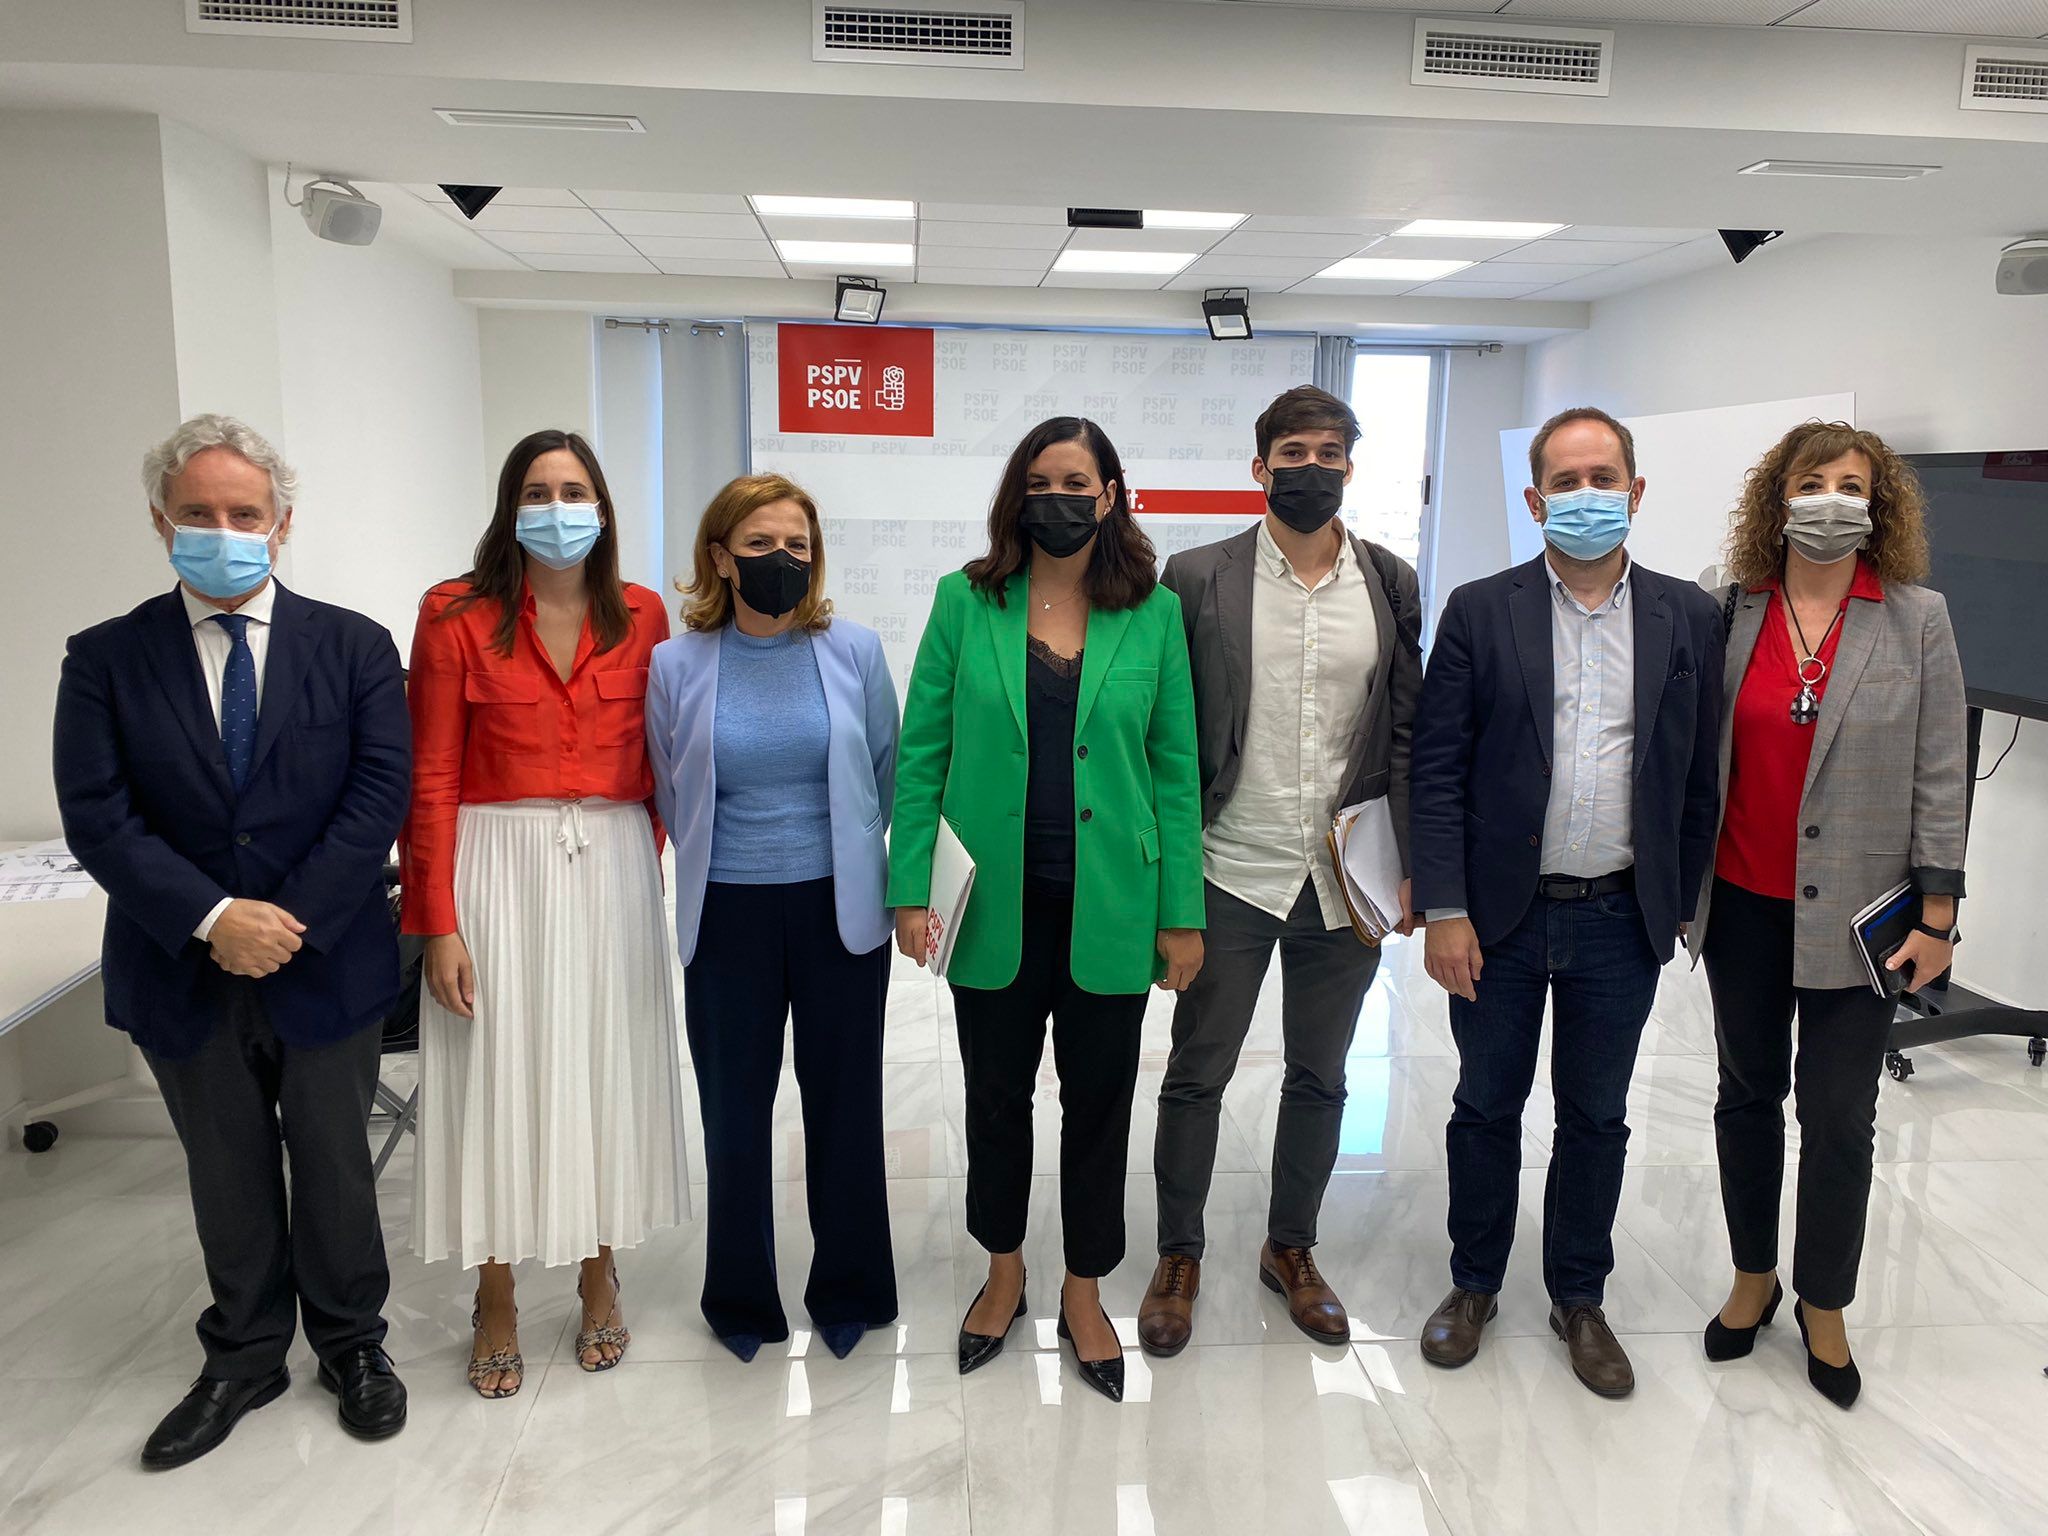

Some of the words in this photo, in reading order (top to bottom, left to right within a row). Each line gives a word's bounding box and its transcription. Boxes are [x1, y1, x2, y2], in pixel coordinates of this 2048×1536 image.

[992, 343, 1028, 356] PSPV
[1053, 344, 1088, 358] PSPV
[1112, 345, 1148, 359] PSPV
[1172, 347, 1207, 361] PSPV
[1231, 347, 1266, 361] PSPV
[992, 359, 1027, 372] PSOE
[1053, 360, 1087, 373] PSOE
[1112, 361, 1147, 375] PSOE
[1171, 363, 1205, 376] PSOE
[1230, 363, 1264, 377] PSOE
[807, 365, 862, 386] PSPV
[808, 389, 861, 410] PSOE
[964, 392, 999, 406] PSPV
[1024, 394, 1059, 408] PSPV
[1083, 396, 1117, 409] PSPV
[1142, 398, 1177, 411] PSPV
[1202, 398, 1236, 411] PSPV
[963, 408, 998, 421] PSOE
[1142, 412, 1176, 425] PSOE
[1201, 413, 1235, 426] PSOE
[810, 440, 846, 453] PSPV
[872, 441, 907, 454] PSPV
[932, 443, 967, 456] PSPV
[1169, 448, 1204, 460] PSPV
[872, 520, 907, 532] PSPV
[932, 521, 966, 534] PSPV
[1167, 525, 1200, 538] PSPV
[872, 535, 906, 548] PSOE
[932, 536, 966, 549] PSOE
[844, 568, 879, 580] PSPV
[844, 582, 878, 595] PSOE
[873, 616, 907, 629] PSPV
[881, 631, 906, 643] SOE
